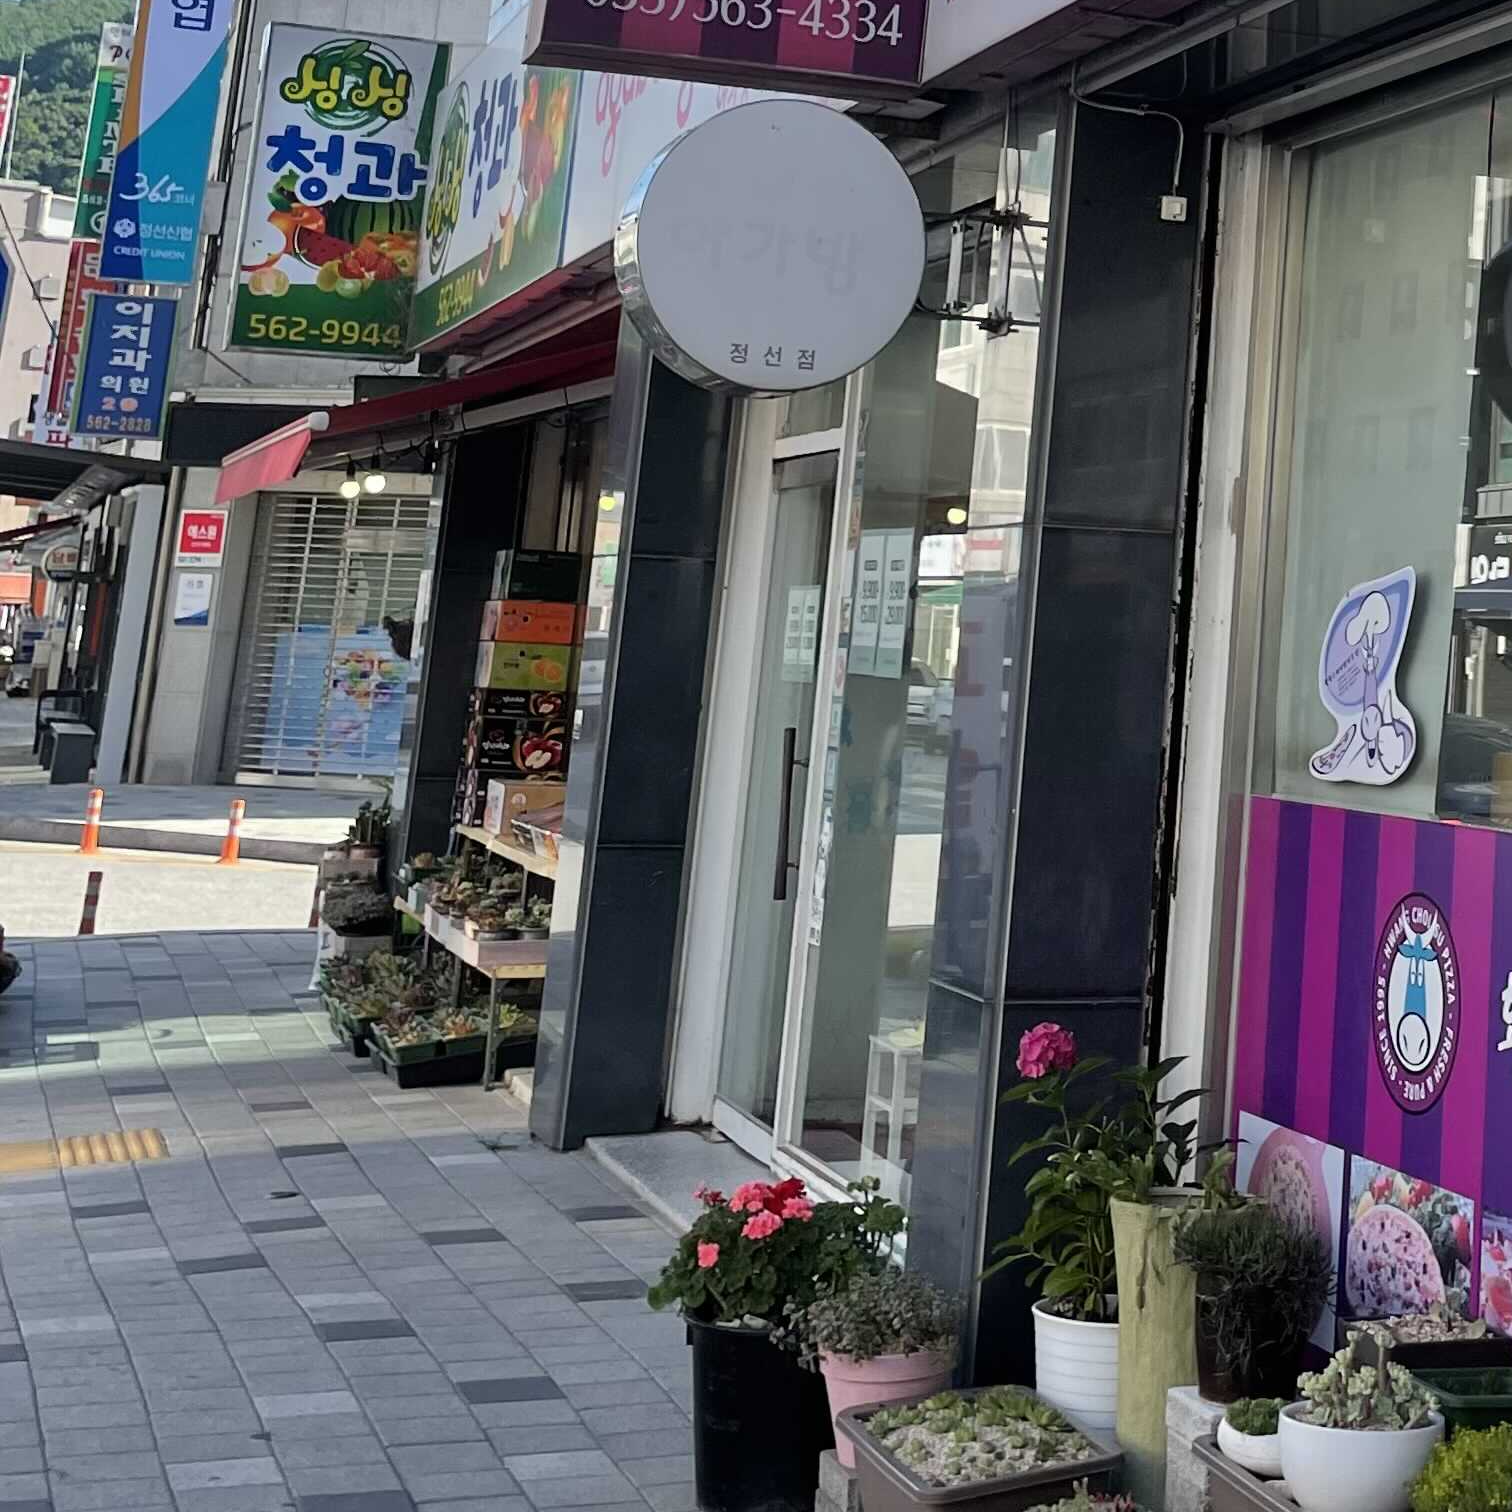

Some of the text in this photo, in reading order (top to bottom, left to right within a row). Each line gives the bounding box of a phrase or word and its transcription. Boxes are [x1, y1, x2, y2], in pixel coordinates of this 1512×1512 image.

[281, 55, 411, 119] 싱싱
[469, 71, 519, 219] 청과
[266, 124, 427, 202] 청과
[119, 172, 185, 204] 365
[113, 245, 148, 258] CREDIT
[248, 314, 402, 348] 562-9944
[730, 343, 816, 371] 정선점
